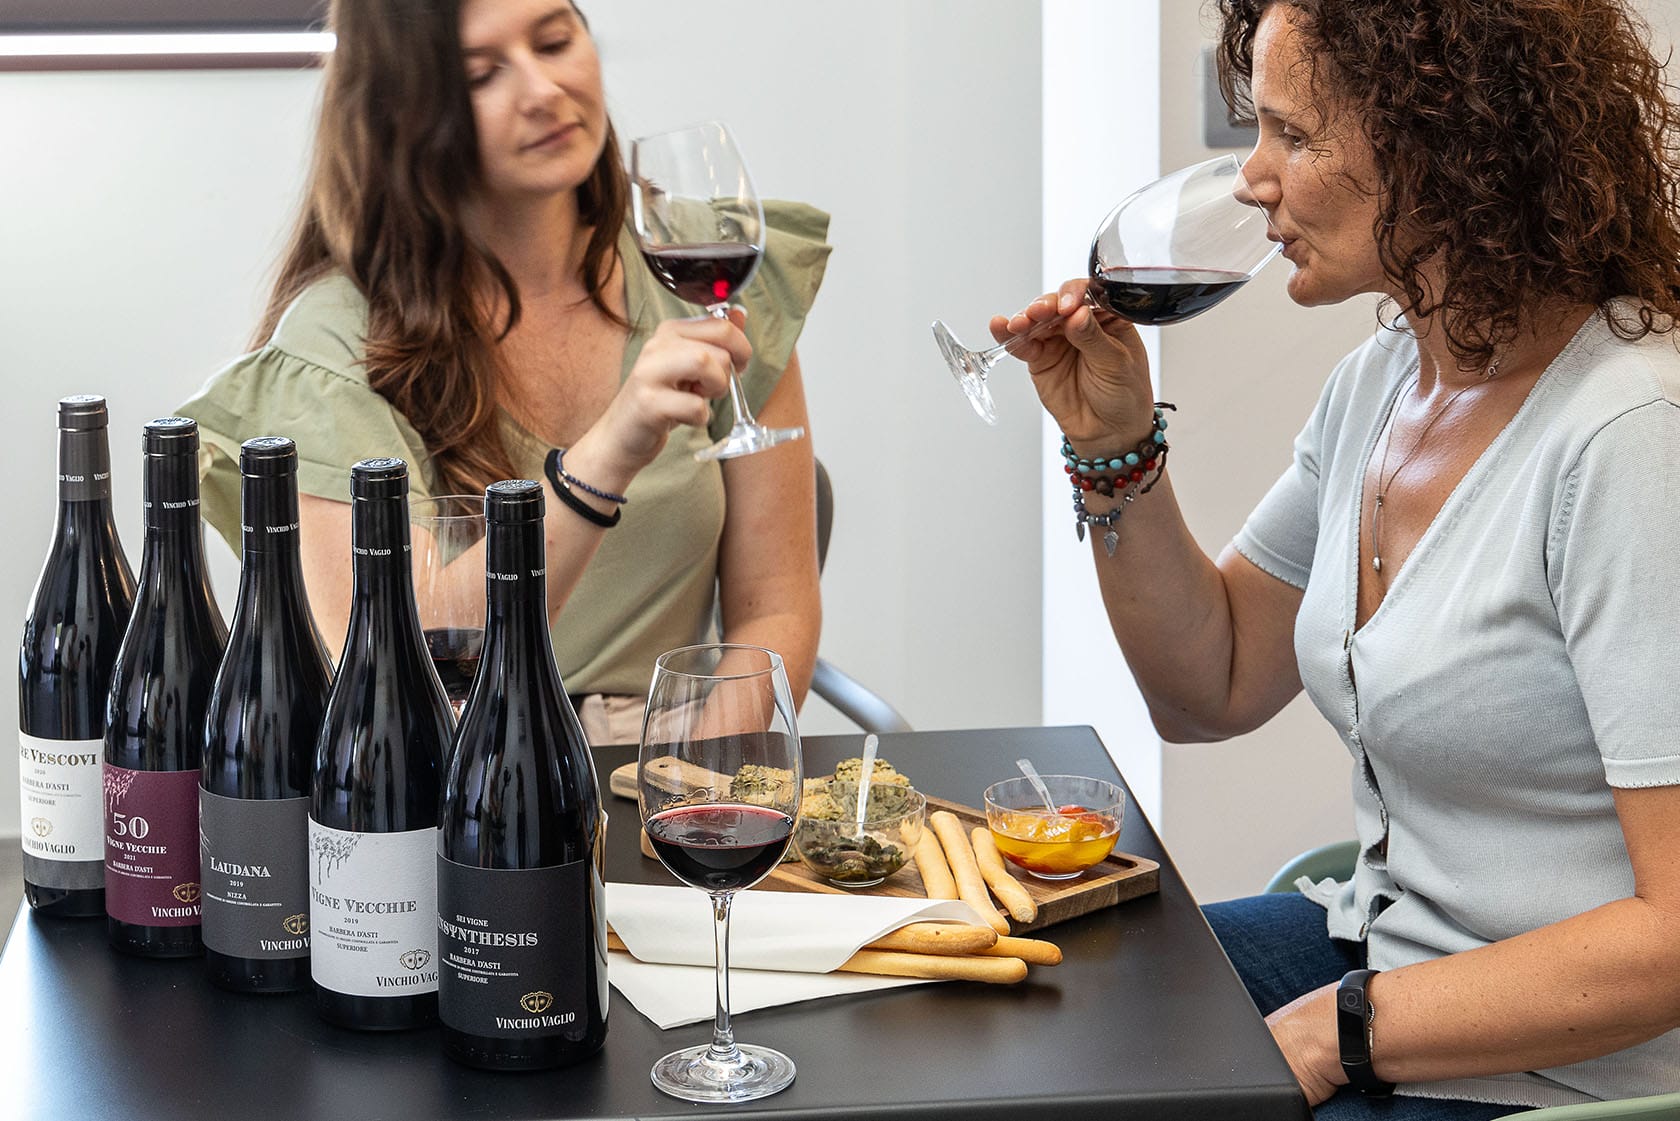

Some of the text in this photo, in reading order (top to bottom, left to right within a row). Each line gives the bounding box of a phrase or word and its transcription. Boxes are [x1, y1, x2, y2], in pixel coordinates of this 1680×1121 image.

[369, 548, 392, 556] VAGLIO
[497, 572, 519, 581] VAGLIO
[30, 748, 98, 767] VESCOVI
[113, 811, 150, 840] 50
[44, 841, 76, 854] VAGLIO
[125, 842, 168, 855] VECCHIE
[209, 856, 272, 878] LAUDANA
[229, 880, 244, 888] 2019
[226, 890, 248, 900] NIZZA
[311, 886, 418, 915] VIGNE VECCHIE
[151, 904, 193, 918] VINCHIO
[343, 917, 360, 925] 2019
[466, 916, 490, 928] VIGNE
[260, 938, 303, 952] VINCHIO
[463, 946, 481, 956] 2017
[376, 971, 439, 989] VINCHIO VAG
[496, 1011, 576, 1030] VINCHIO VAGLIO
